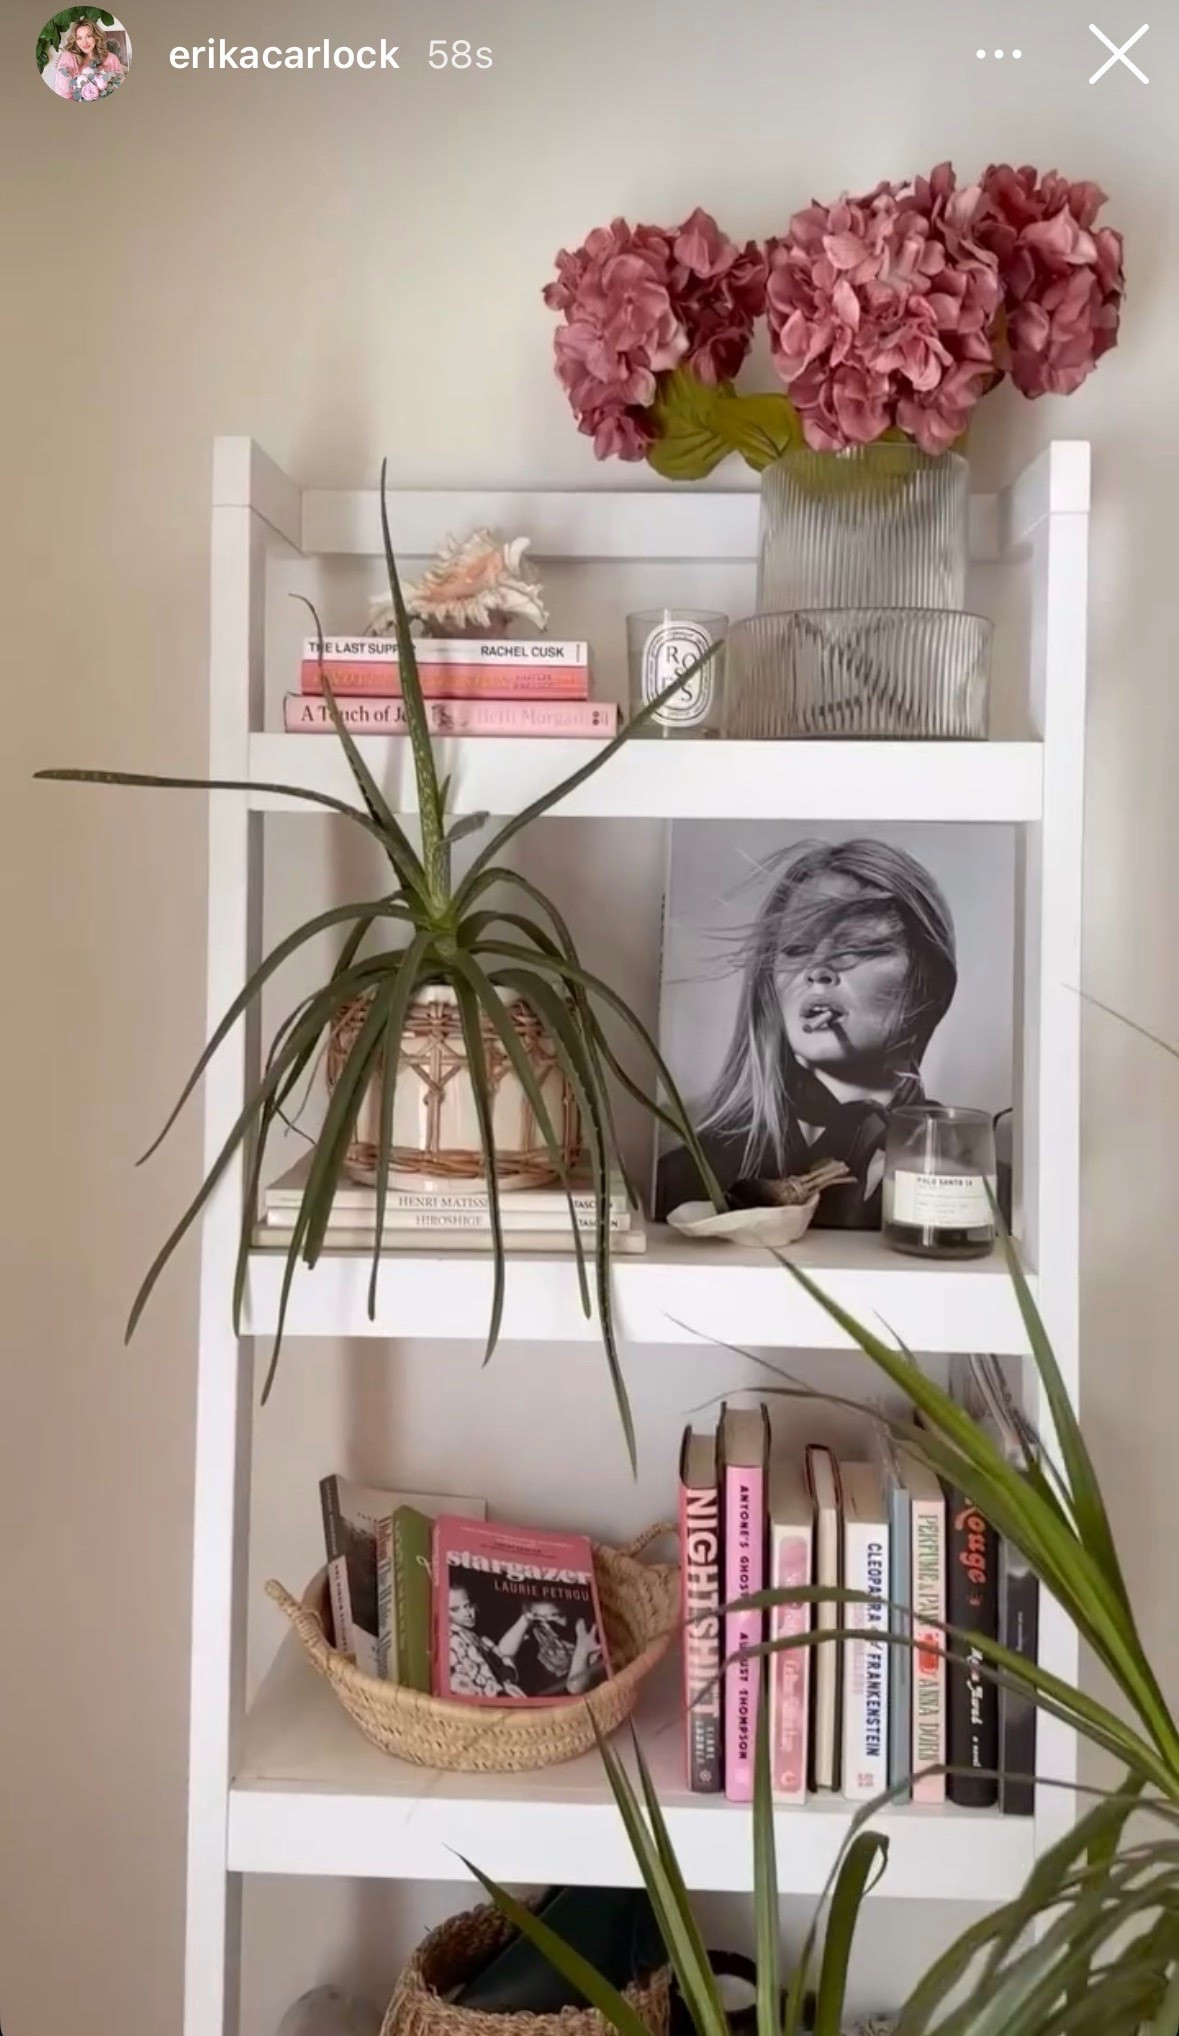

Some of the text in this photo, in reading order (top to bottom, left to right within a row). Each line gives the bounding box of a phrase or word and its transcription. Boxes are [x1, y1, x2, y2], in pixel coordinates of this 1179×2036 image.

[335, 642, 366, 654] LAST
[480, 645, 564, 658] RACHEL CUSK
[301, 705, 314, 722] A
[317, 705, 369, 722] Tuch
[373, 705, 391, 722] of
[440, 1197, 488, 1209] MATISS
[917, 1513, 940, 1581] PERFUME
[446, 1549, 592, 1585] stargazer
[494, 1579, 537, 1598] LAURIE
[738, 1632, 750, 1760] AUUST THOMPSON
[865, 1653, 883, 1758] FRANKENSTEIN
[917, 1678, 940, 1717] ANNA
